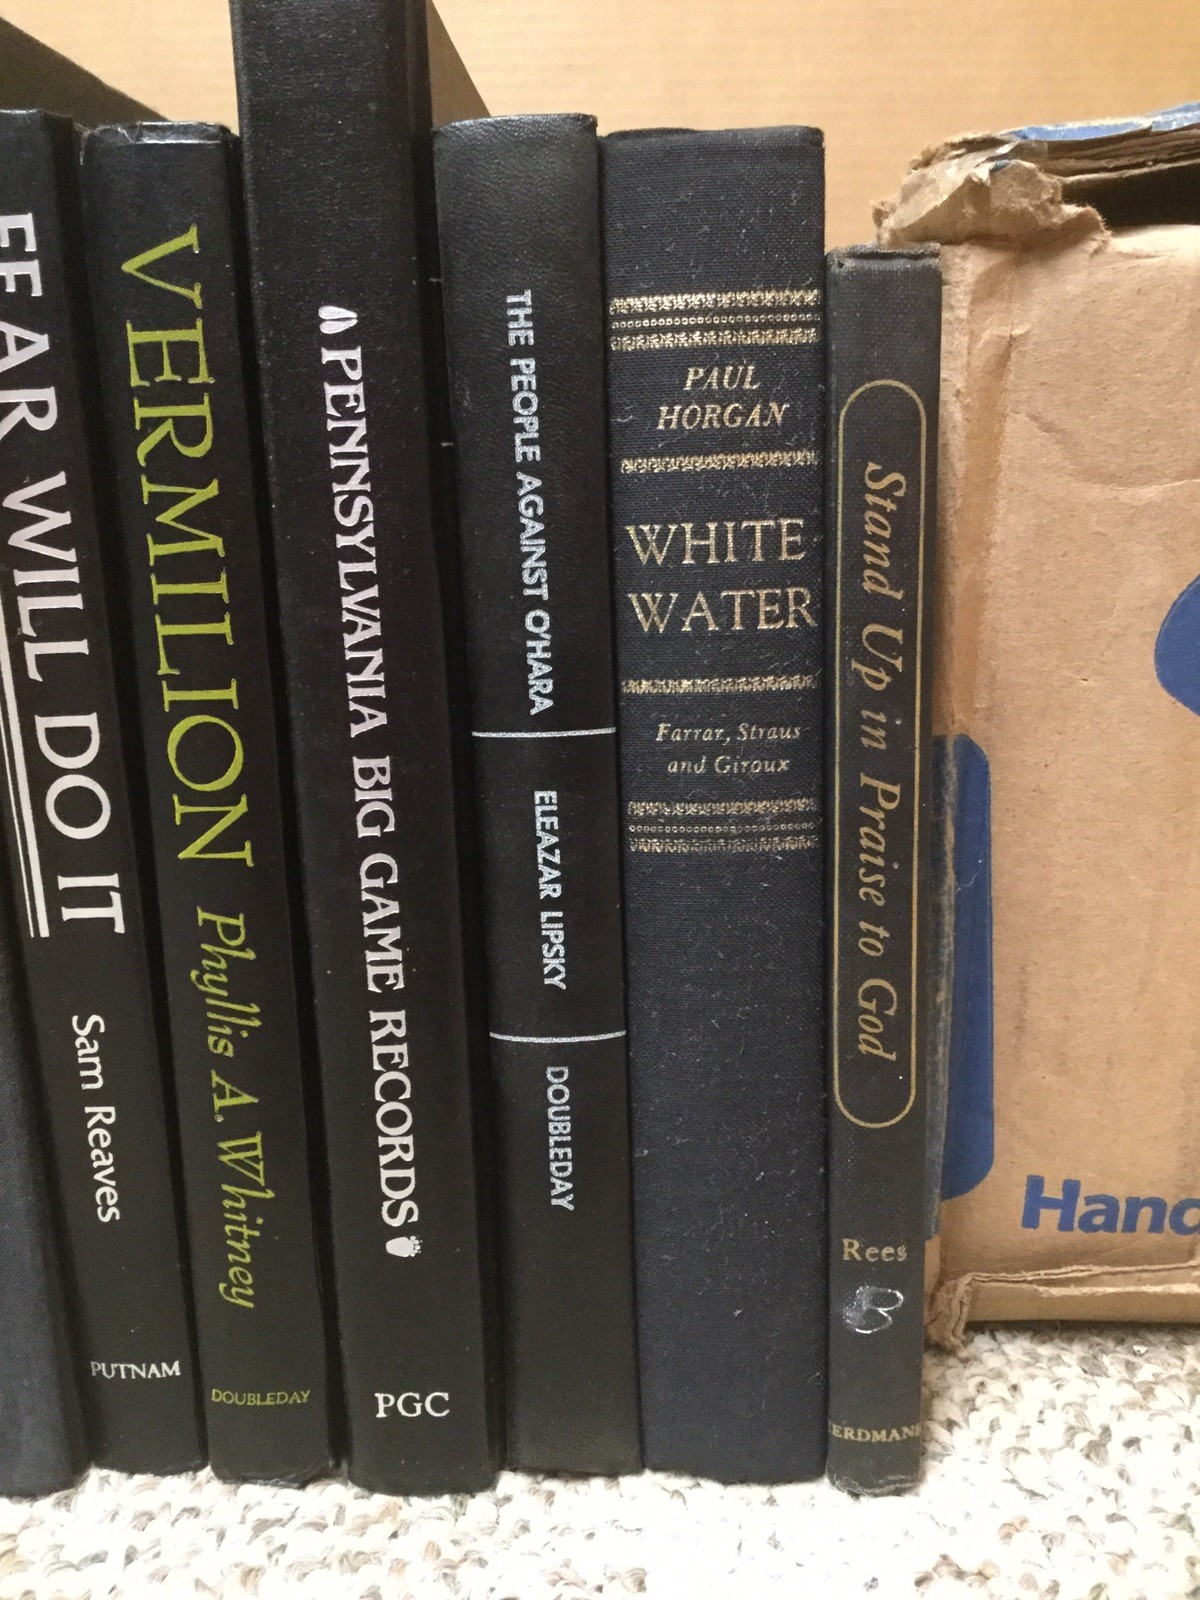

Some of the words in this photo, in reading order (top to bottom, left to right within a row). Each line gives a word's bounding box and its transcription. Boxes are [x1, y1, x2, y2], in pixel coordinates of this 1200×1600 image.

[506, 289, 534, 346] THE
[510, 358, 541, 462] PEOPLE
[657, 402, 790, 430] HORGAN
[683, 365, 761, 390] PAUL
[121, 224, 254, 867] VERMILION
[321, 346, 388, 737] PENNSYLVANIA
[516, 472, 549, 600] AGAINST
[624, 518, 806, 566] WHITE
[862, 461, 907, 600] Stand
[3, 471, 90, 682] WILL
[627, 587, 817, 633] WATER
[525, 609, 553, 715] O'HARA
[851, 622, 903, 691] Up
[656, 723, 730, 746] Farrar,
[737, 723, 801, 741] Straus
[667, 756, 706, 773] and
[714, 756, 790, 773] Giroux
[860, 709, 901, 749] in
[34, 711, 111, 842] DO
[353, 756, 395, 838] BIG
[534, 791, 562, 899] ELEAZAR
[858, 771, 901, 906] Praise
[58, 873, 125, 933] IT
[360, 853, 404, 993] GAME
[858, 920, 890, 957] to
[190, 906, 261, 1057] Phyllis
[541, 912, 566, 990] LIPSKY
[72, 1015, 106, 1090] Sam
[857, 977, 898, 1061] God
[211, 1070, 259, 1122] A.
[369, 1010, 418, 1227] RECORDS
[85, 1107, 120, 1222] Reaves
[546, 1067, 574, 1211] DOUBLEDAY
[217, 1131, 275, 1308] Whitney
[842, 1238, 908, 1261] Rees
[91, 1361, 181, 1379] PUTNAM
[211, 1389, 310, 1405] DOUBLEDAY
[375, 1392, 449, 1417] PGC
